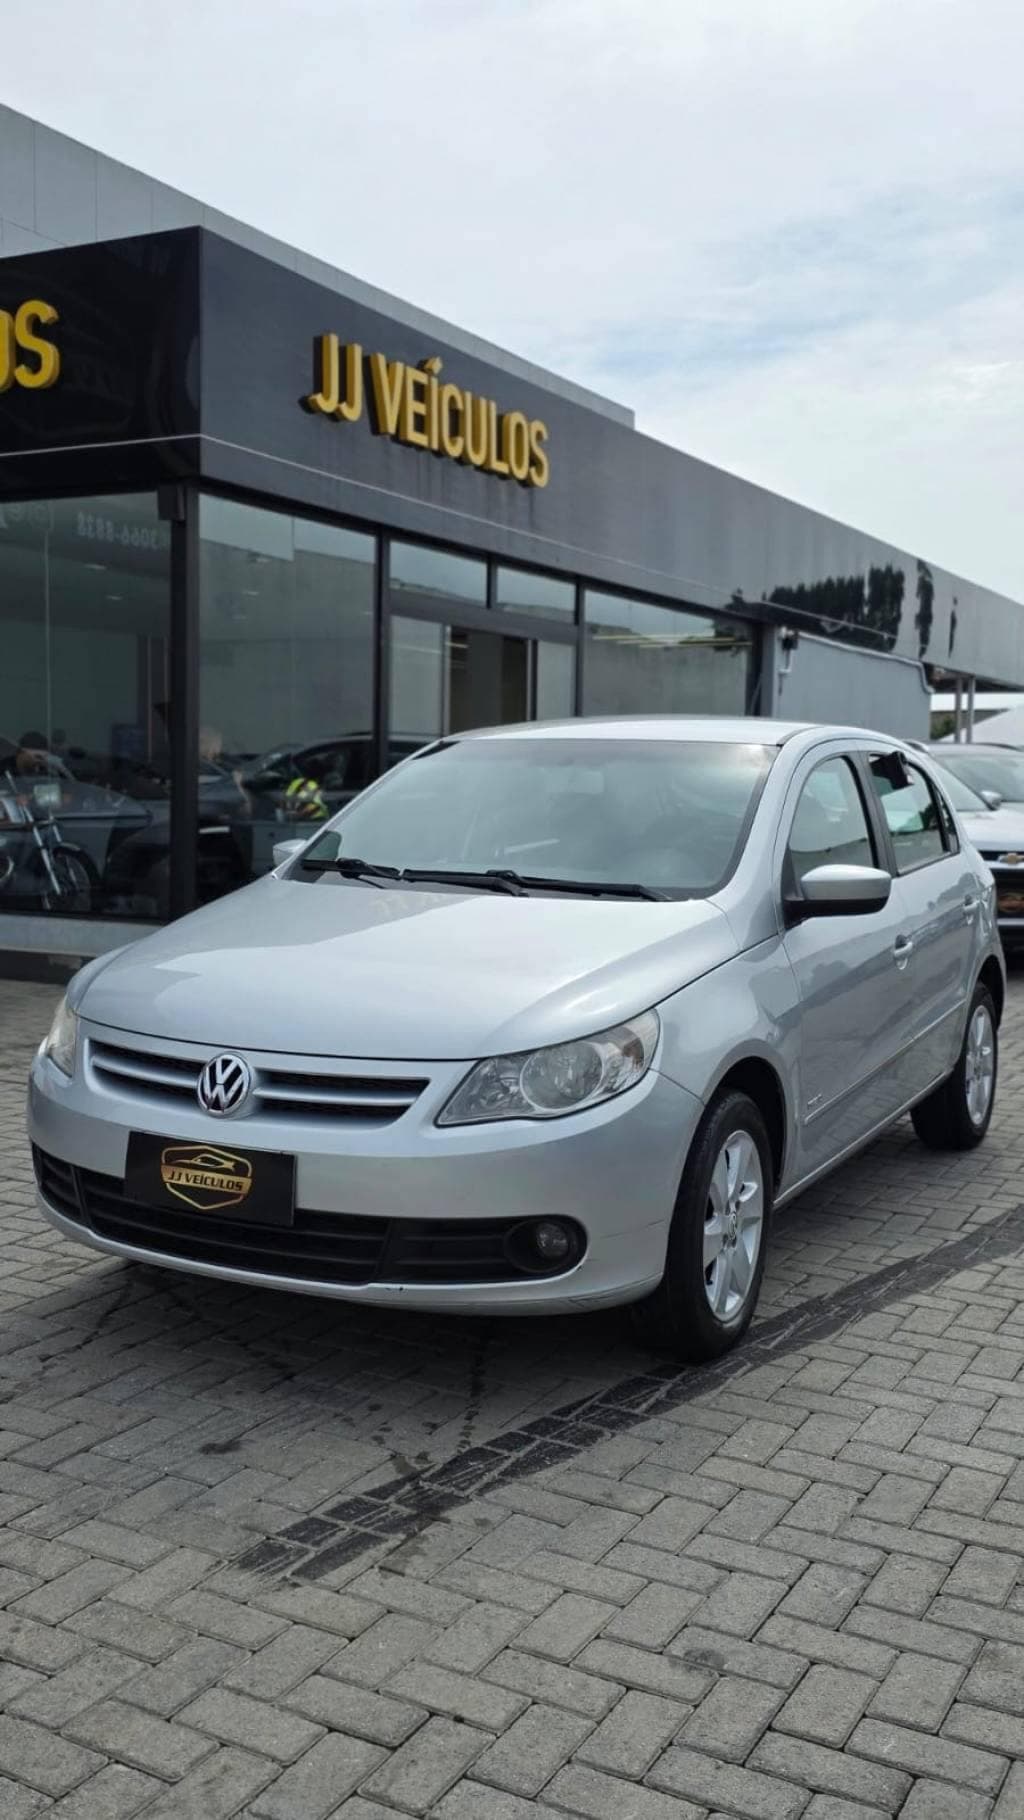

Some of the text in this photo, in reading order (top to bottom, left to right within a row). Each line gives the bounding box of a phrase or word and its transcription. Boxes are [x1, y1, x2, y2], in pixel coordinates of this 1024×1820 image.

[308, 333, 549, 488] JJ VEÍCULOS
[168, 1170, 245, 1192] JJ VEÍCULOS
